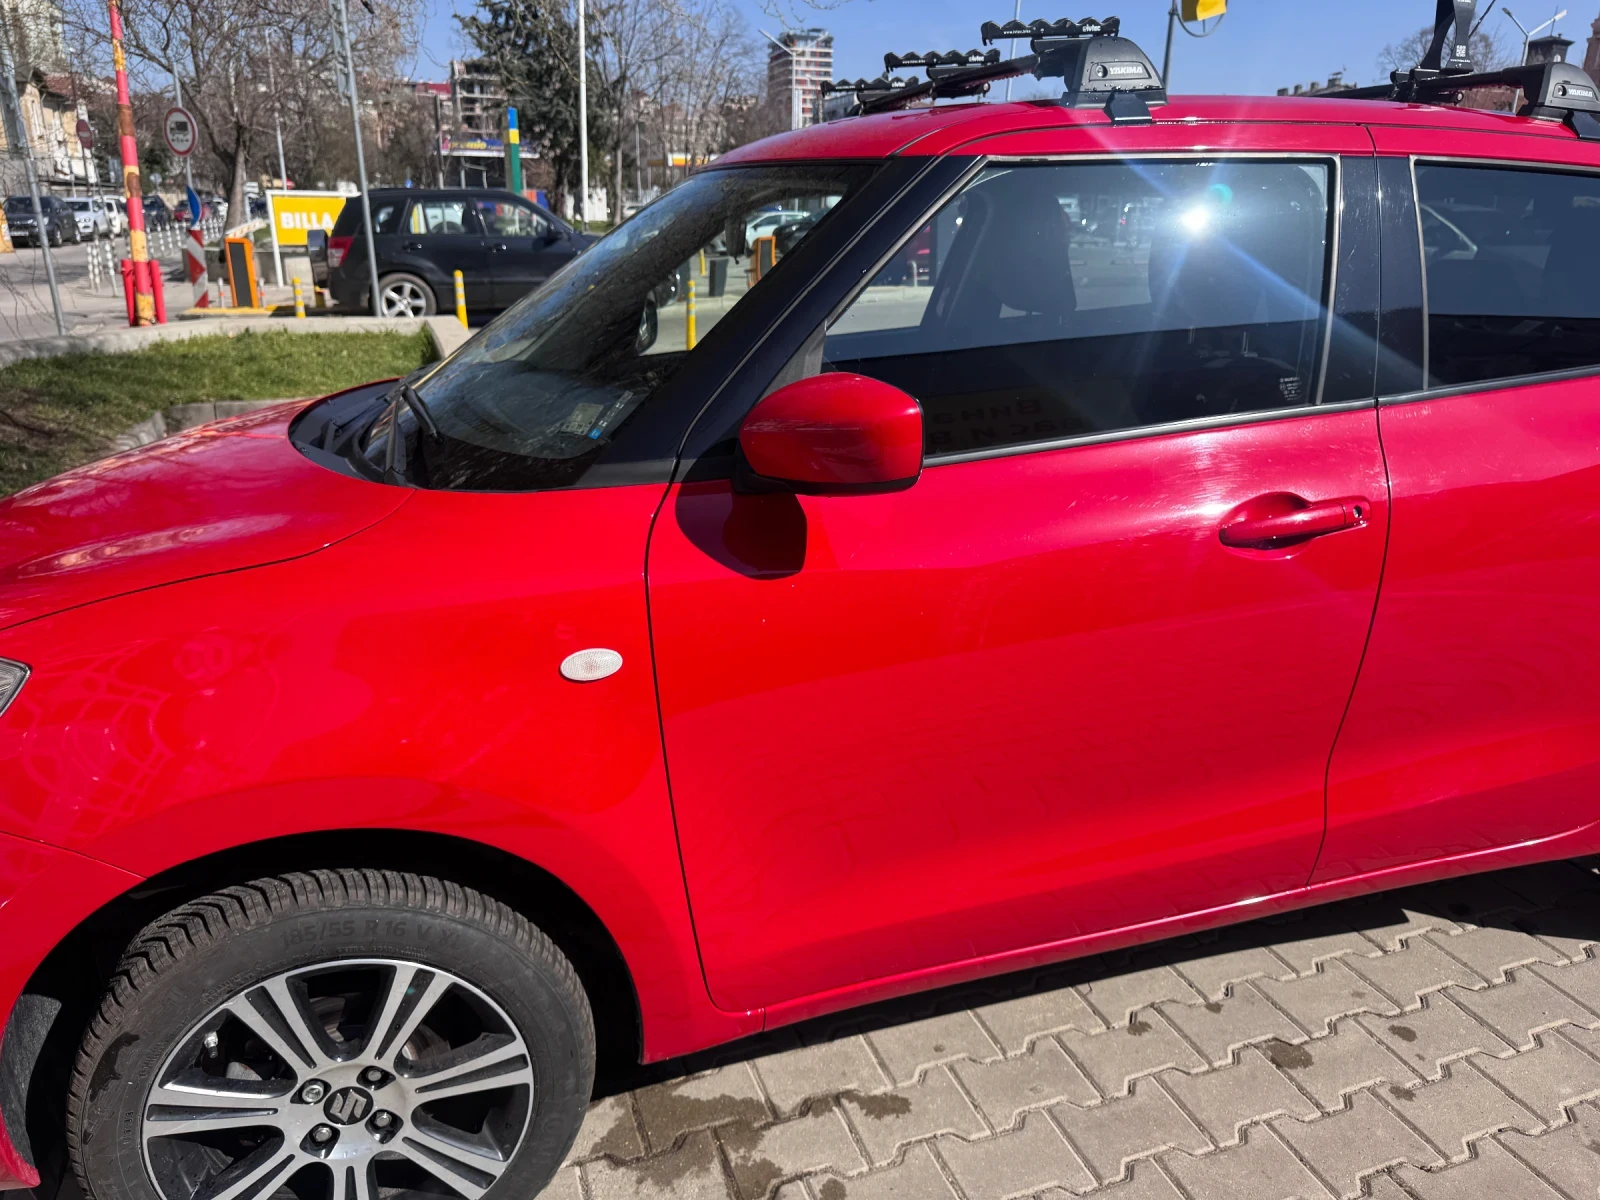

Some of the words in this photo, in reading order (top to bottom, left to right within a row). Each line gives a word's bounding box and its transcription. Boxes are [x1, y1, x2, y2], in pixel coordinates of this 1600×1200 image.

[1109, 66, 1143, 75] YAKIMA
[1568, 88, 1593, 98] YAKIMA
[280, 211, 334, 230] BILLA
